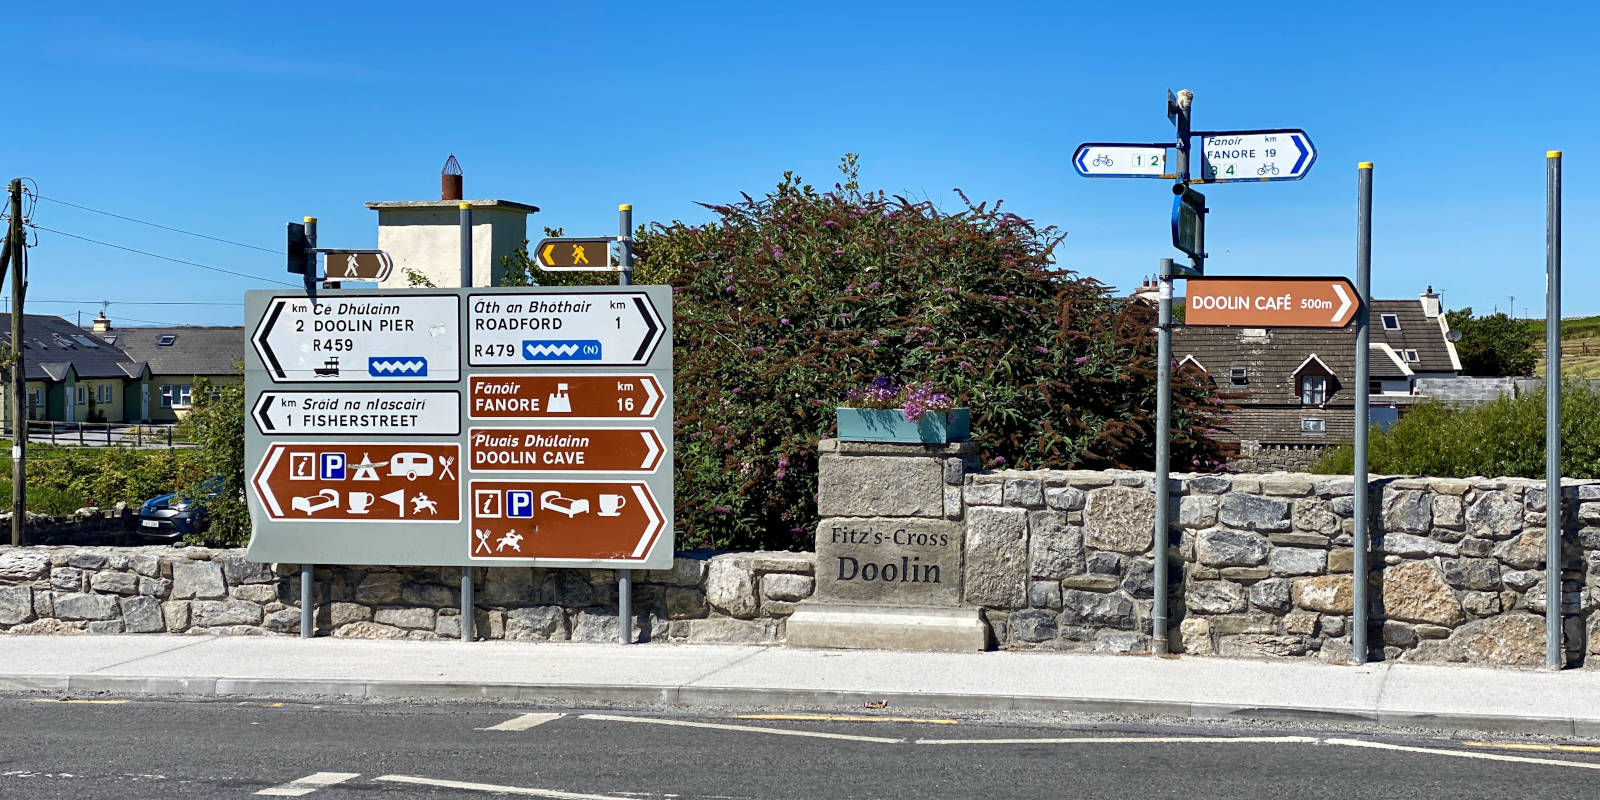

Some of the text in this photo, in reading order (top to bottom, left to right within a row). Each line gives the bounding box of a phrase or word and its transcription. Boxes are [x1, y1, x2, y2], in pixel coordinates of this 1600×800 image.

[1207, 148, 1276, 159] FANORE 19
[1151, 155, 1159, 166] 2
[1226, 165, 1235, 175] 4
[506, 304, 522, 313] an
[529, 300, 592, 313] Bhóthair
[610, 300, 626, 309] km
[1192, 294, 1332, 310] DOOLIN CAFÉ 500m
[292, 304, 307, 313] km
[313, 303, 400, 315] Cé Dhúlainn
[296, 320, 304, 332] 2
[314, 319, 414, 332] DOOLIN PIER
[476, 318, 562, 330] ROADFORD
[615, 317, 621, 329] 1
[313, 339, 353, 352] R459
[474, 344, 515, 356] R479
[474, 381, 520, 394] Fánóir
[617, 381, 634, 390] km
[281, 398, 297, 407] km
[302, 398, 339, 410] Sráid
[344, 401, 360, 410] na
[476, 399, 540, 411] FANORE
[617, 398, 634, 411] 16
[287, 415, 292, 426] 1
[304, 415, 418, 427] FISHERSTREET
[475, 434, 589, 447] Pluais Dhúlainn
[476, 452, 585, 464] DOOLIN CAVE
[326, 457, 340, 477] P
[513, 494, 528, 515] P
[831, 527, 948, 546] Fitz's-Cross
[836, 556, 941, 583] Doolin
